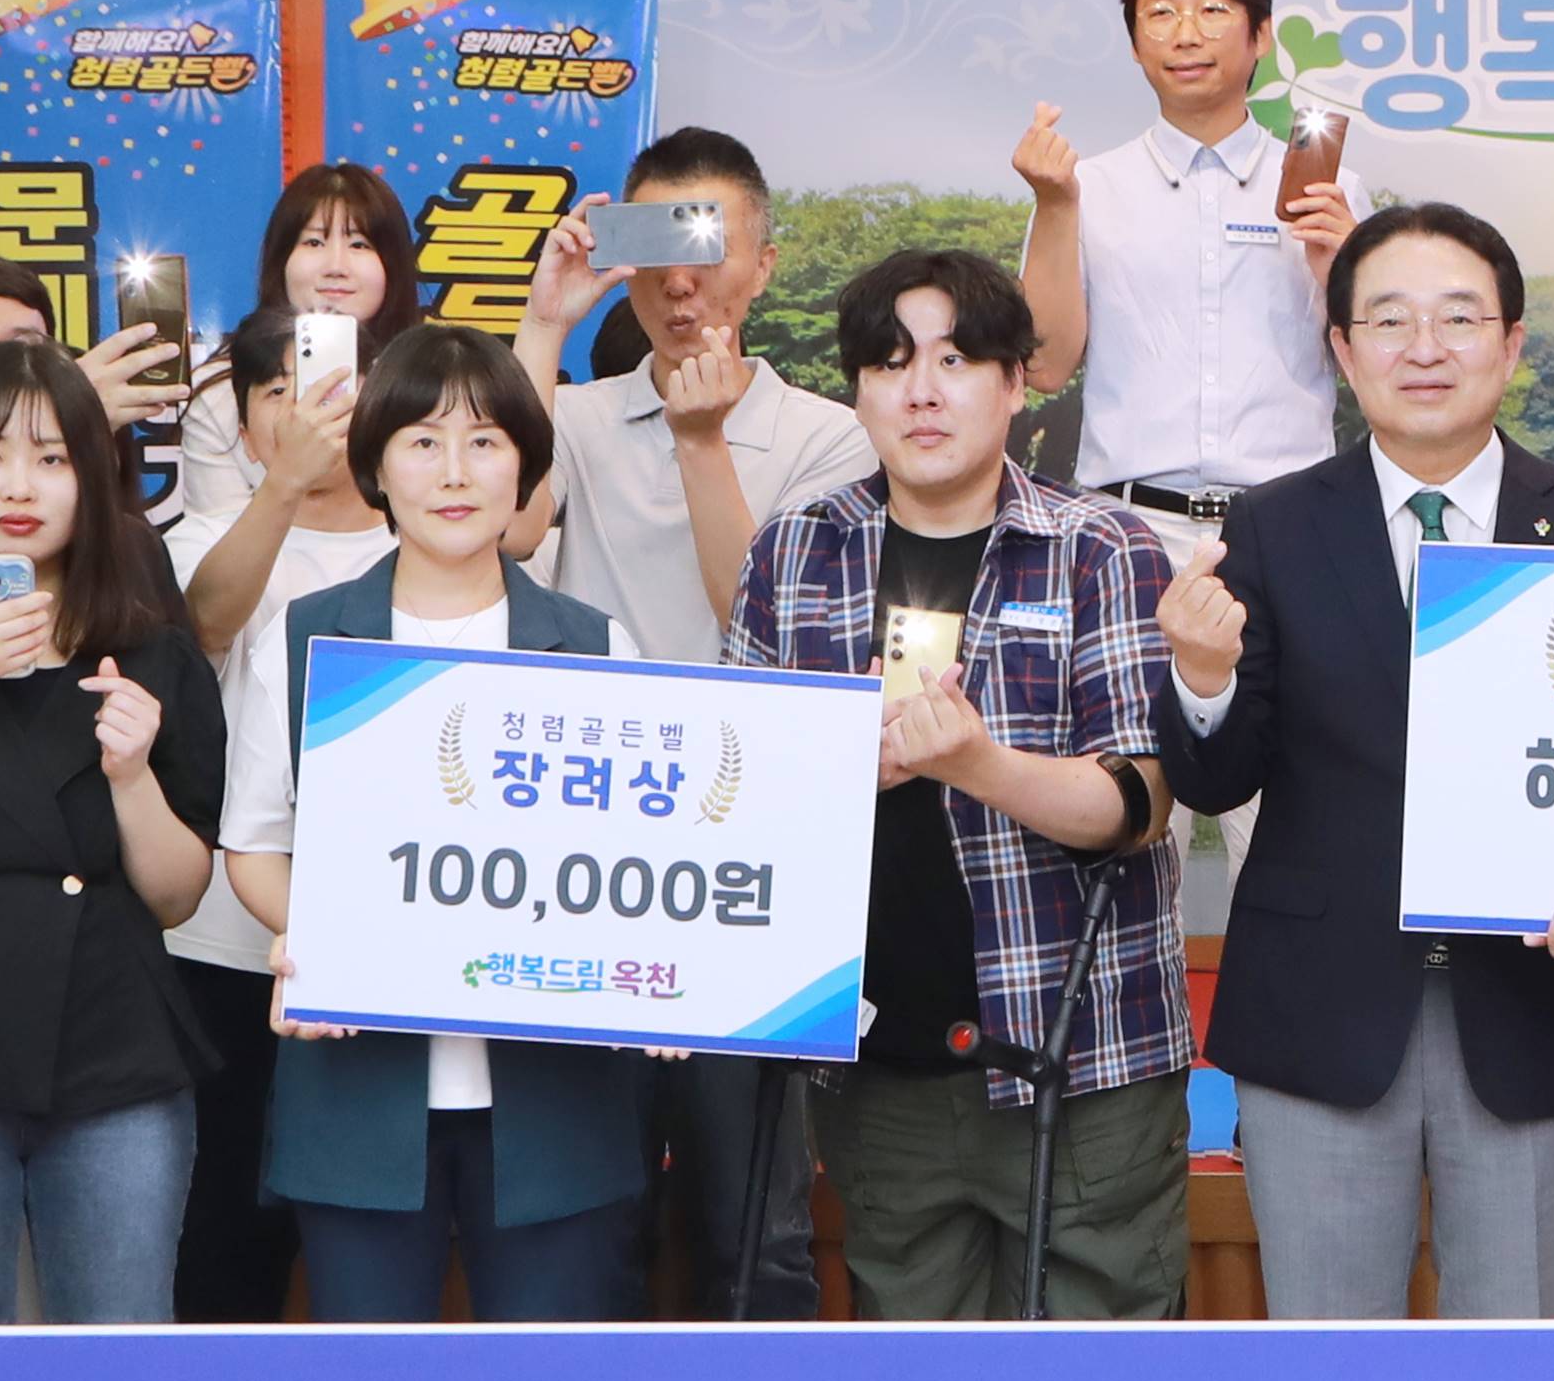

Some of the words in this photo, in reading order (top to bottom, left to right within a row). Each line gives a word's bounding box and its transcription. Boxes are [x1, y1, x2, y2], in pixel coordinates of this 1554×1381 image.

[70, 28, 186, 55] 함께해요!
[458, 29, 571, 56] 함께해요!
[70, 56, 255, 92] 청렴골든벨
[455, 57, 636, 96] 청렴골든벨
[492, 749, 686, 818] 장려상
[388, 841, 774, 926] 100,000원
[486, 952, 605, 992] 행복드림
[610, 960, 678, 998] 옥천
